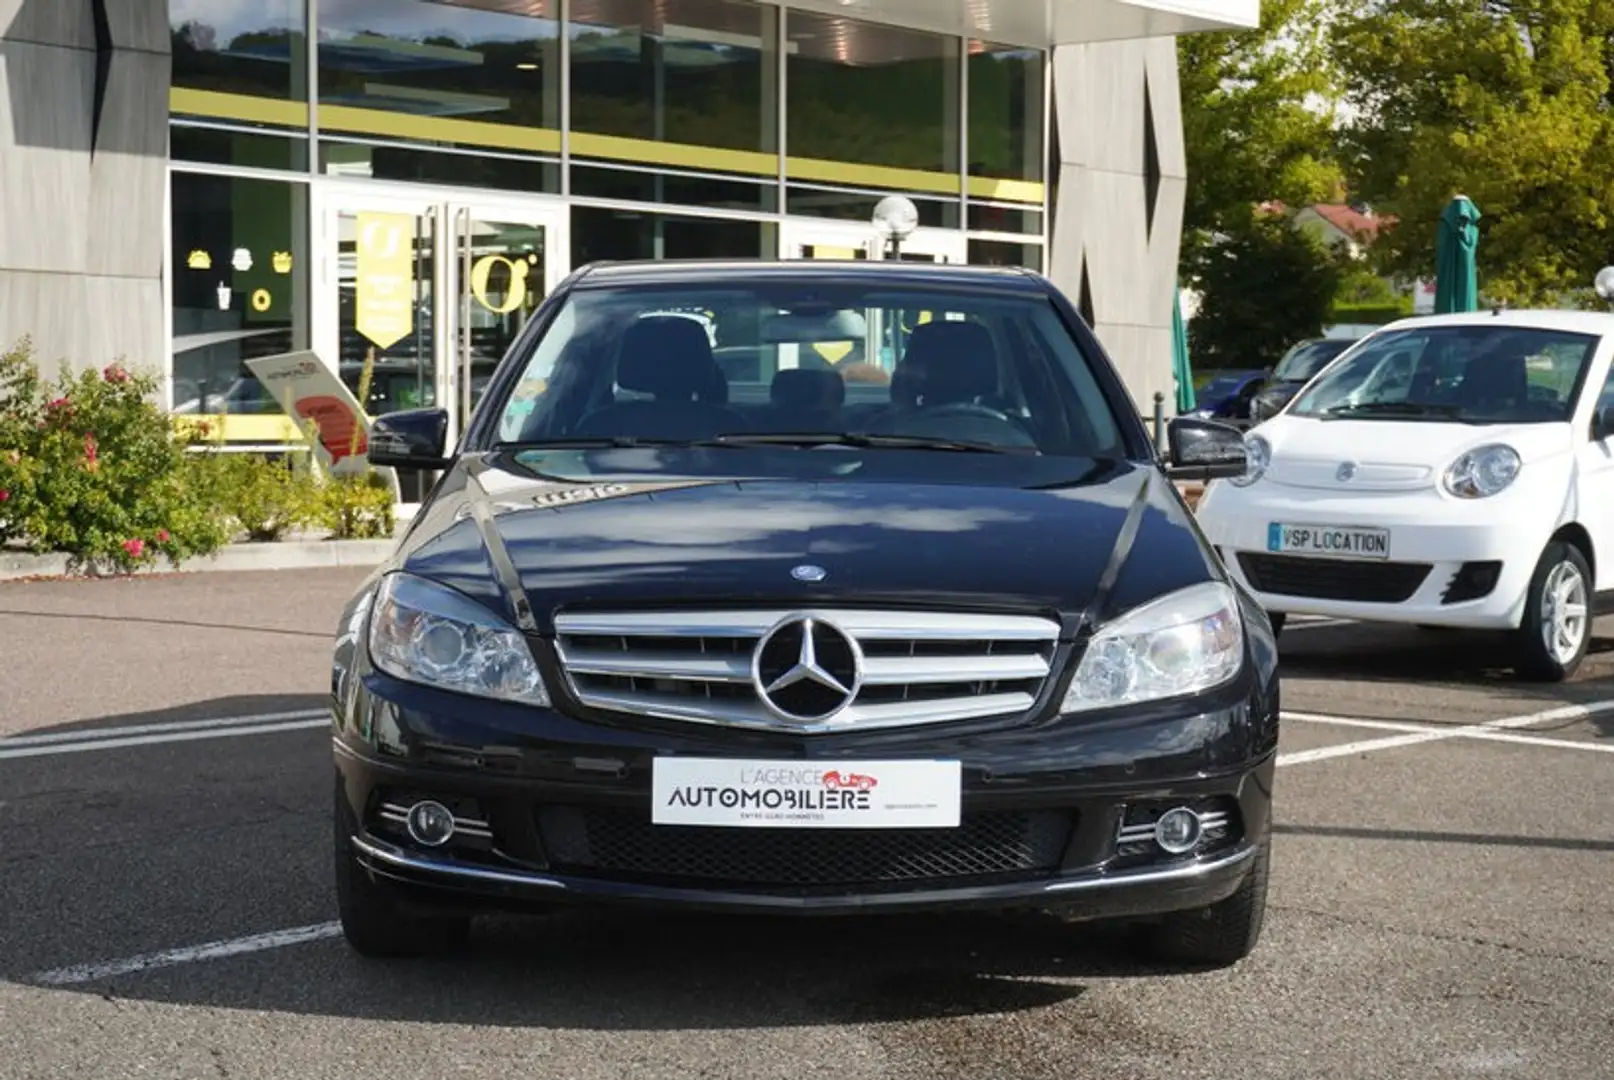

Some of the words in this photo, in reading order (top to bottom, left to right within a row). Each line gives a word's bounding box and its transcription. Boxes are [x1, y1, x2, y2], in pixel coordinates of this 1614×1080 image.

[1284, 528, 1310, 548] VSP
[1313, 531, 1386, 552] LOCATION
[740, 768, 823, 786] L'AGENCE
